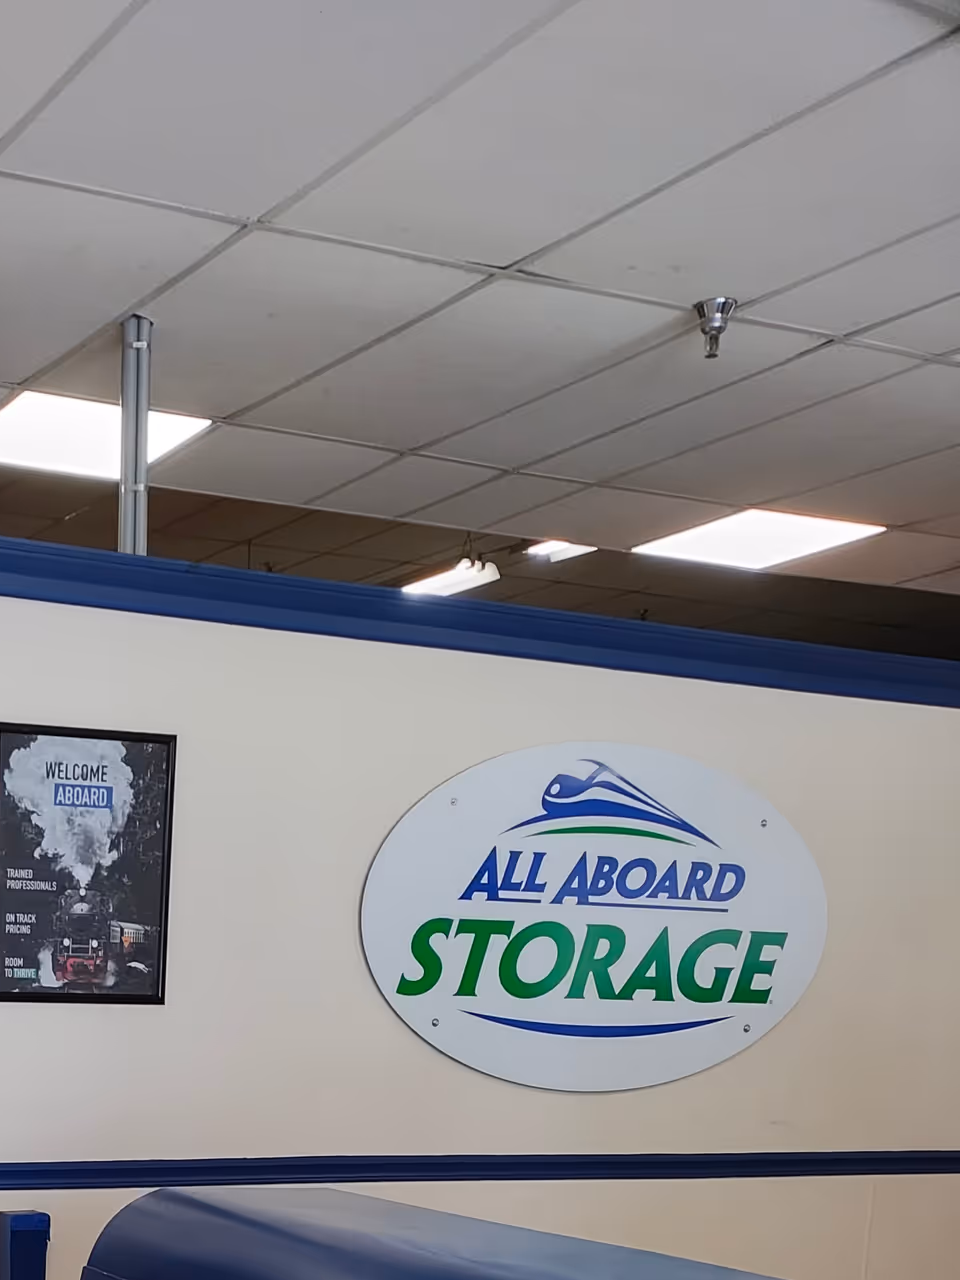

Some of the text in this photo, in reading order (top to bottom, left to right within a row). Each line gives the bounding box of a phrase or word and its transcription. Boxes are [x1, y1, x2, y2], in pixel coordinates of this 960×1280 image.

[45, 761, 108, 782] WELCOME
[6, 868, 33, 879] TRAINED
[458, 845, 746, 905] ALL ABOARD
[6, 880, 57, 891] PROFESSIONALS
[5, 913, 37, 923] ON TRACK
[5, 924, 31, 934] PRICING
[4, 957, 24, 967] ROOM
[396, 917, 788, 1004] STORAGE
[4, 968, 36, 978] TO THRIVE
